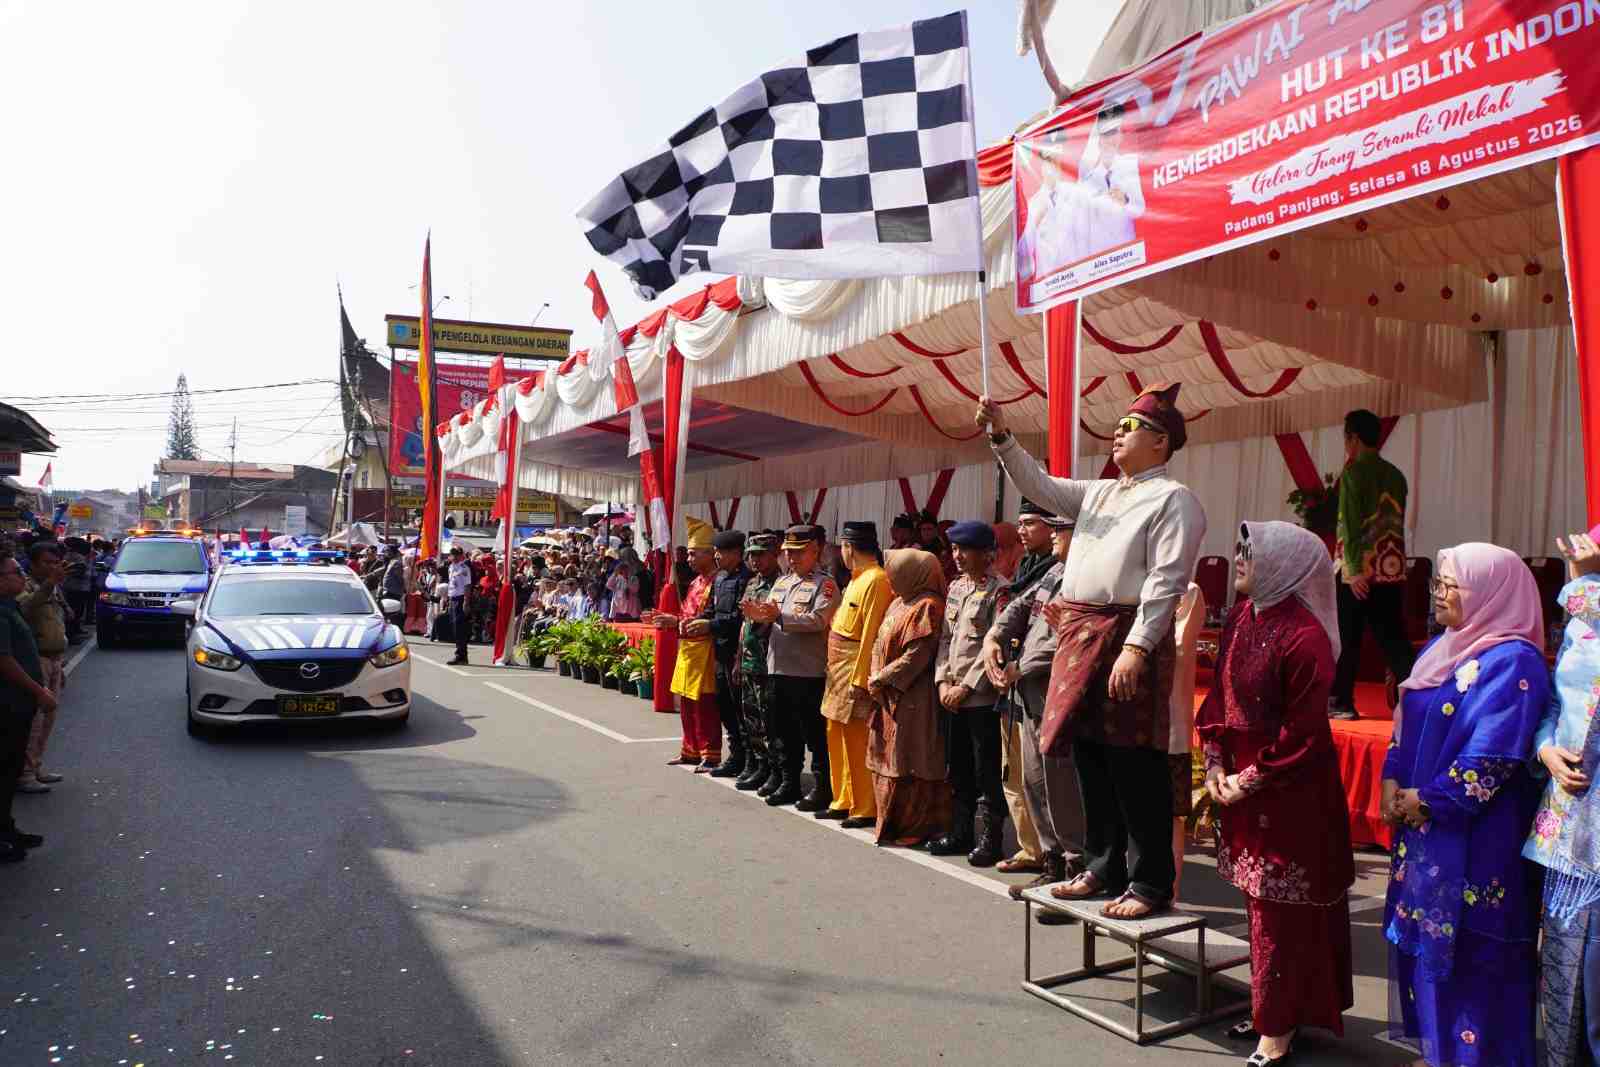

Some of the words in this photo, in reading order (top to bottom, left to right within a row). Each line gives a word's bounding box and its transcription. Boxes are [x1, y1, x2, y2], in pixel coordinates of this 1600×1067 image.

[1193, 4, 1312, 123] PAWAI
[1281, 46, 1349, 102] HUT
[1360, 20, 1409, 70] KE
[1420, 0, 1464, 44] 81
[1152, 104, 1317, 189] KEMERDEKAAN
[1325, 41, 1476, 122] REPUBLIK
[1306, 147, 1356, 176] Juang
[1362, 111, 1434, 157] Serambi
[1224, 208, 1275, 235] Padang
[1279, 190, 1344, 218] Panjang,
[1349, 169, 1406, 196] Selasa
[1411, 160, 1432, 178] 18
[1438, 134, 1521, 170] Agustus
[1527, 114, 1583, 145] 2026
[441, 329, 490, 345] PENGELOLA
[491, 333, 536, 348] KEUANGAN
[537, 336, 568, 351] DAERAH
